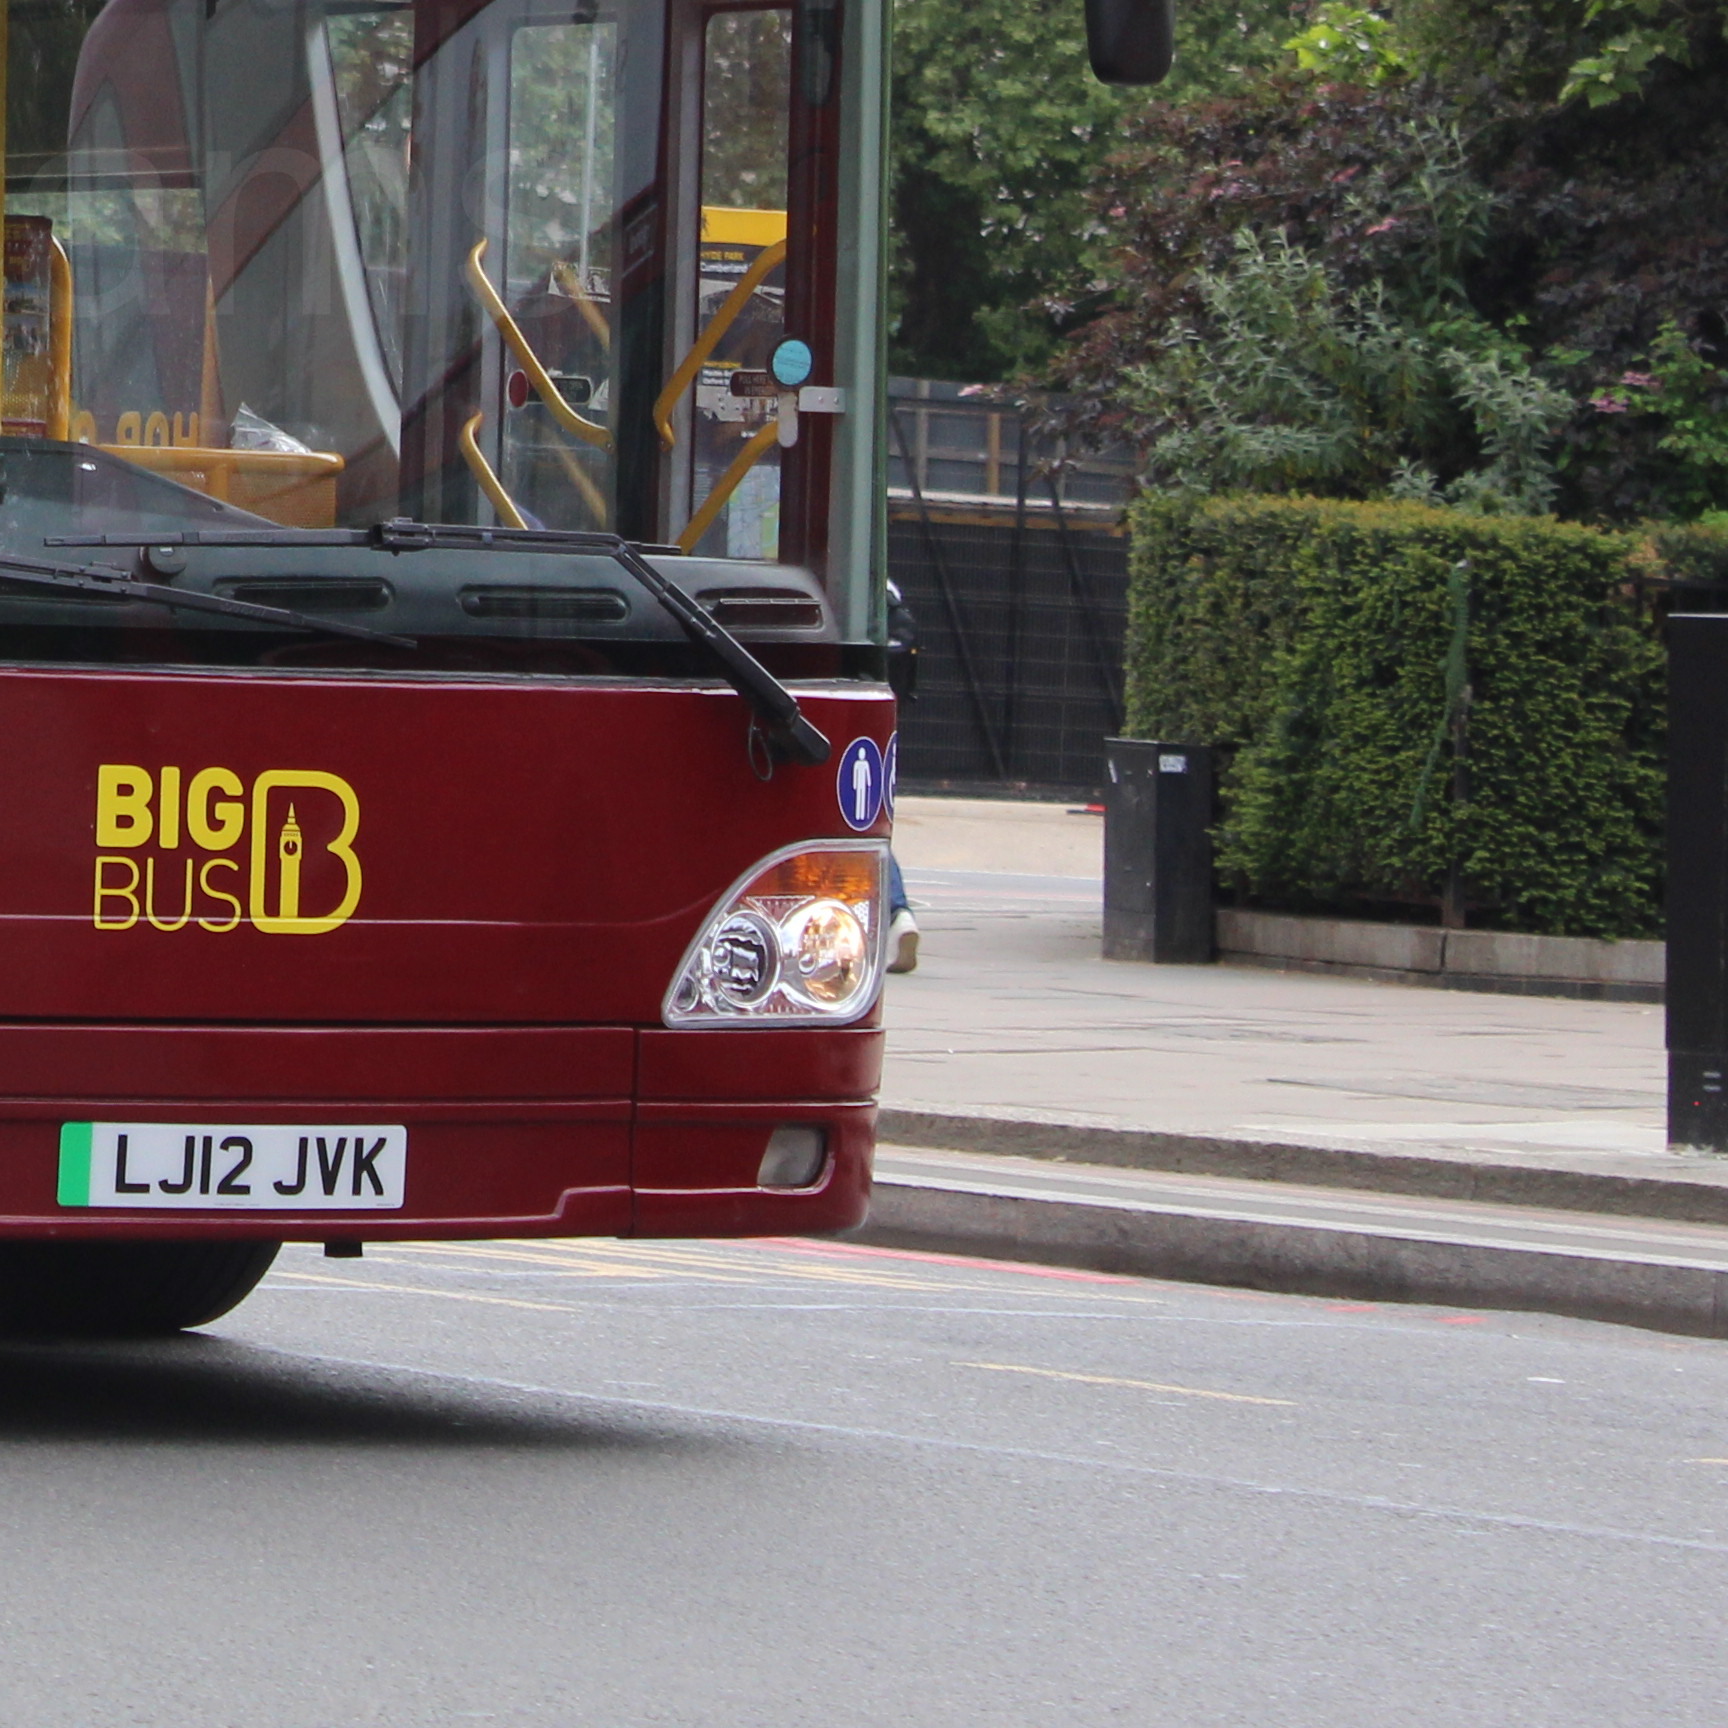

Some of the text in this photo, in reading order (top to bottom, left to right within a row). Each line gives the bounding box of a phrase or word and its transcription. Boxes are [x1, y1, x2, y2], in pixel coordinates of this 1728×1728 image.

[96, 764, 245, 850] BIG
[93, 856, 244, 933] BUS
[114, 1134, 387, 1197] LJ12 JVK
